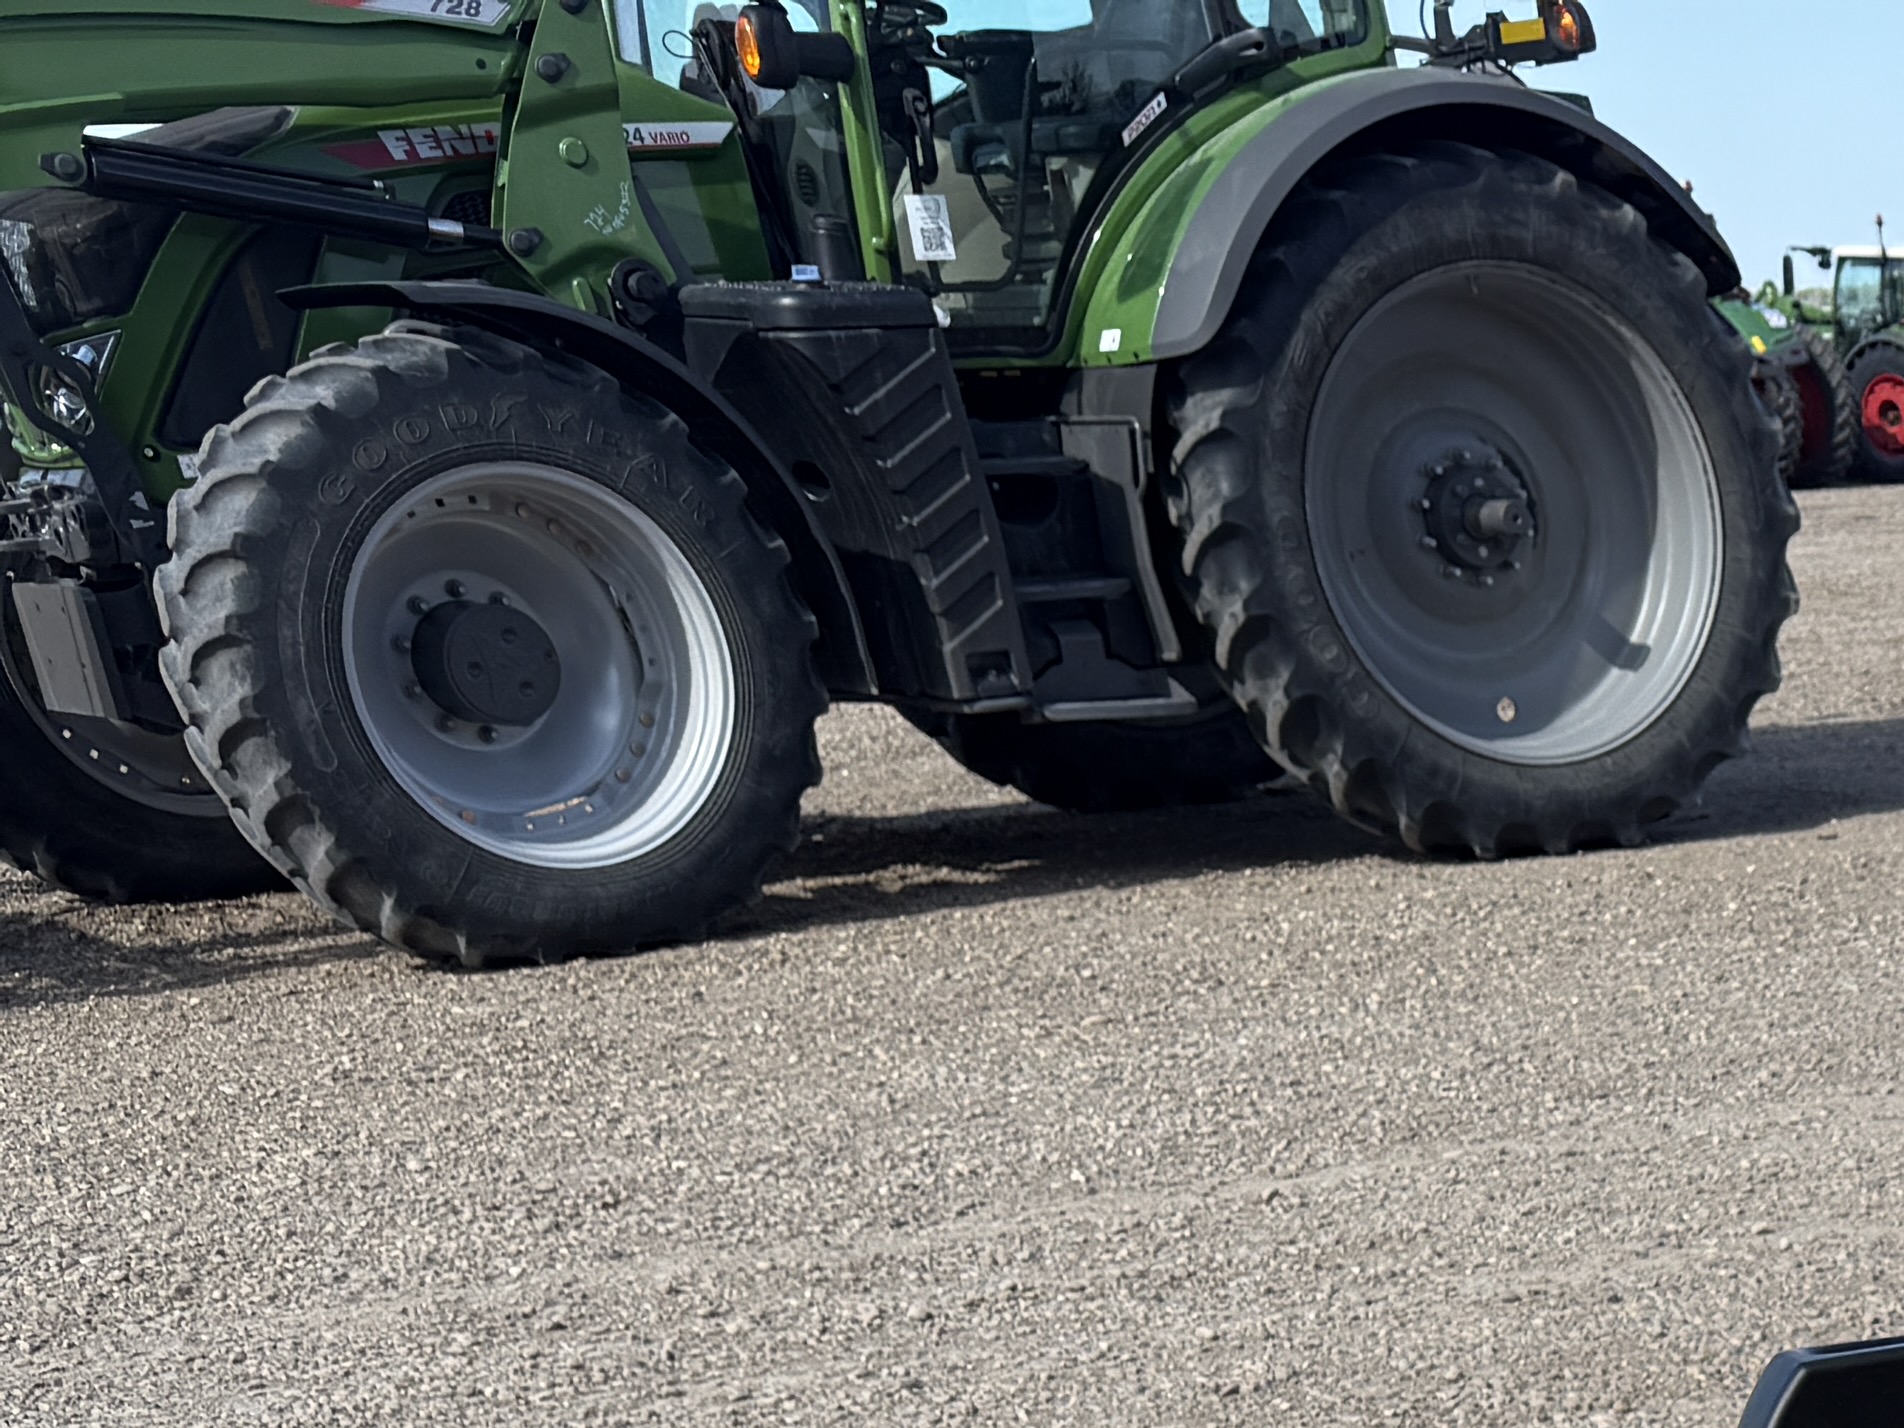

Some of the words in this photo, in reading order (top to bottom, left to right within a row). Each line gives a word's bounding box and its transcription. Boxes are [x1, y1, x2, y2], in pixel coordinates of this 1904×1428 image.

[376, 122, 501, 161] FEND
[622, 126, 645, 145] 24
[648, 130, 690, 144] VARIO
